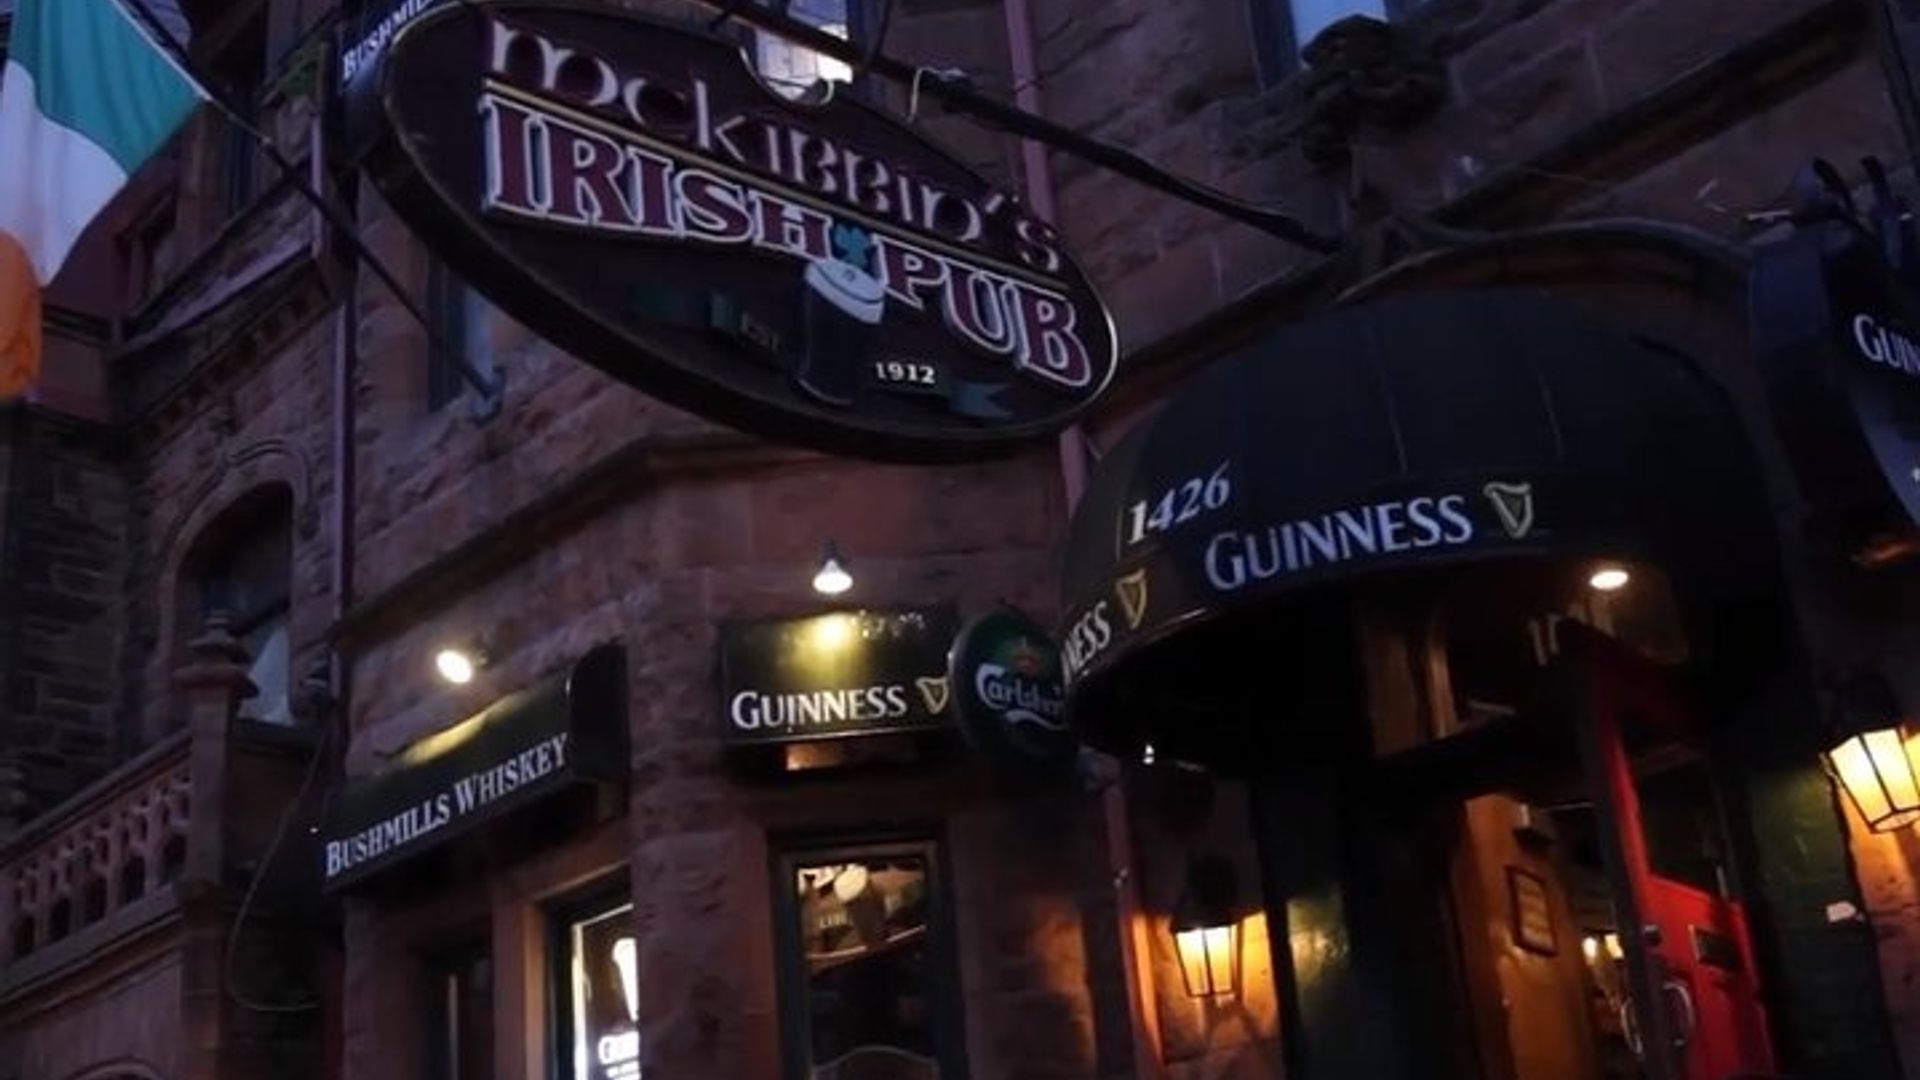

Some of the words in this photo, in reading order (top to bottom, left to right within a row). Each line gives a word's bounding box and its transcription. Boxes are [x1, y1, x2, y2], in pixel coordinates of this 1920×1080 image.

[478, 93, 834, 261] IRISH
[869, 232, 1093, 389] PUB
[874, 359, 936, 385] 1912
[1127, 458, 1231, 546] 1426
[1204, 494, 1475, 592] GUINNESS
[730, 684, 908, 731] GUINNESS
[975, 661, 1067, 713] Carlsber
[325, 792, 451, 879] BUSHMILLS
[453, 731, 569, 816] WHISKEY
